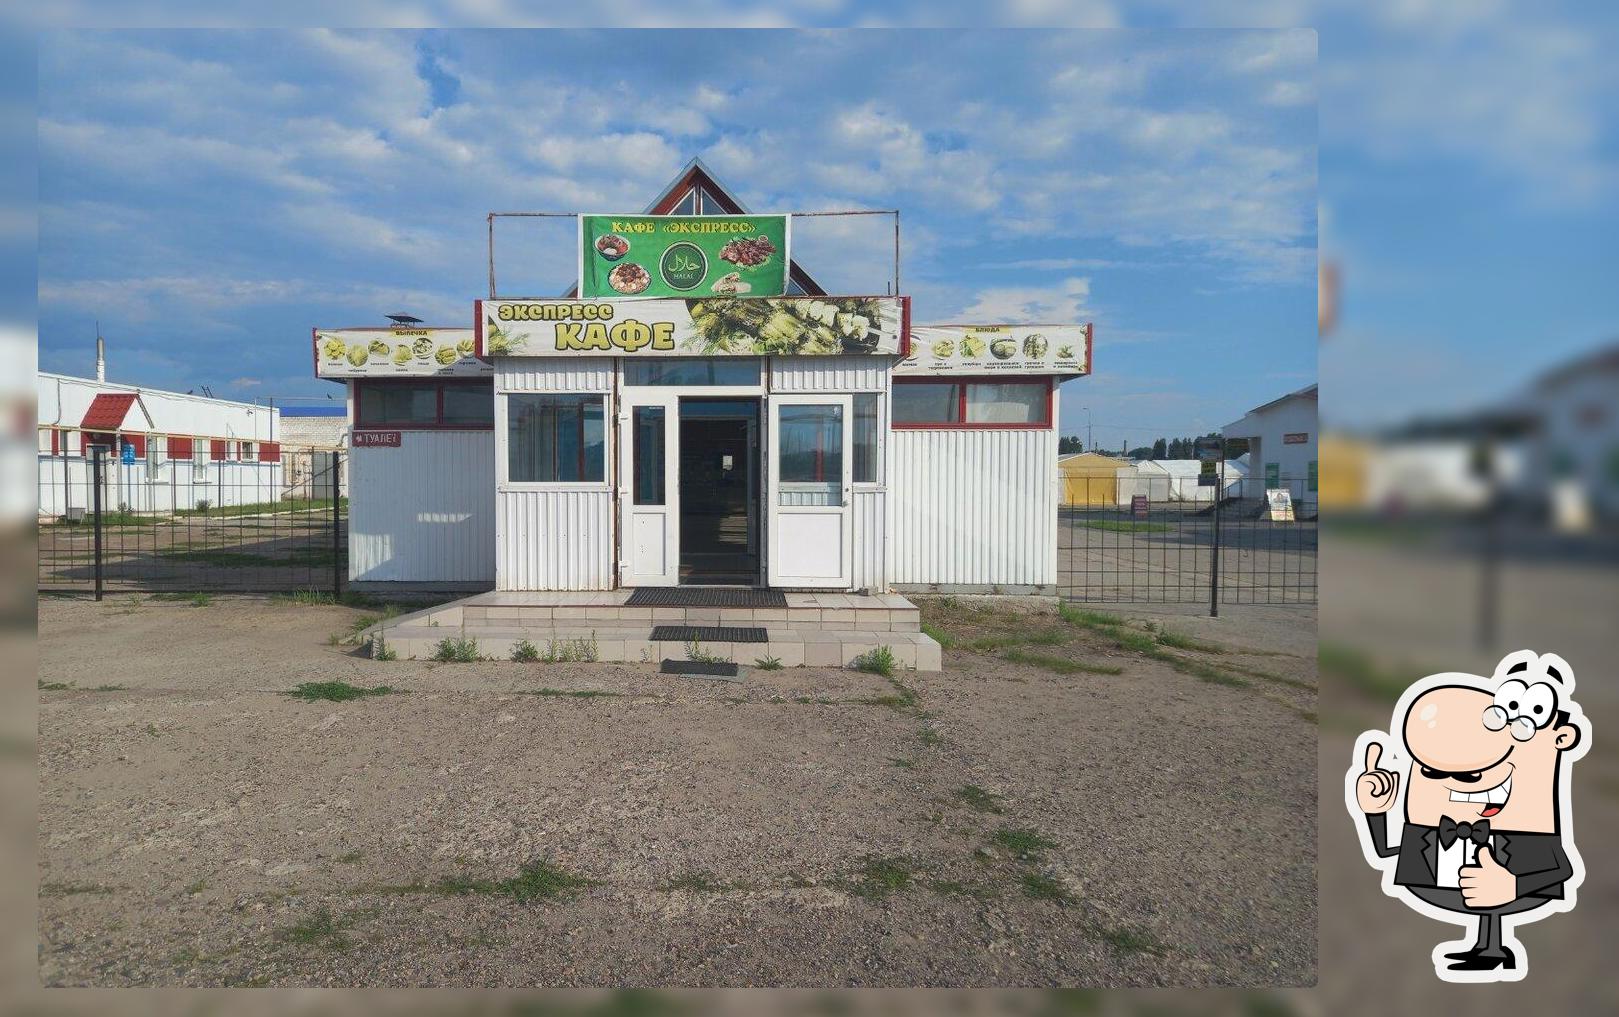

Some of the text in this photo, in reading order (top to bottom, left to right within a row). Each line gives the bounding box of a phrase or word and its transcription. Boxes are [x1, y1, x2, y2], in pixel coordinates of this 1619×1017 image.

[611, 221, 756, 233] КАФЕ «ЭКСПРЕСС»
[669, 254, 701, 272] حلال
[498, 303, 614, 321] ЭКСПРЕСС
[554, 319, 676, 353] КАФЕ
